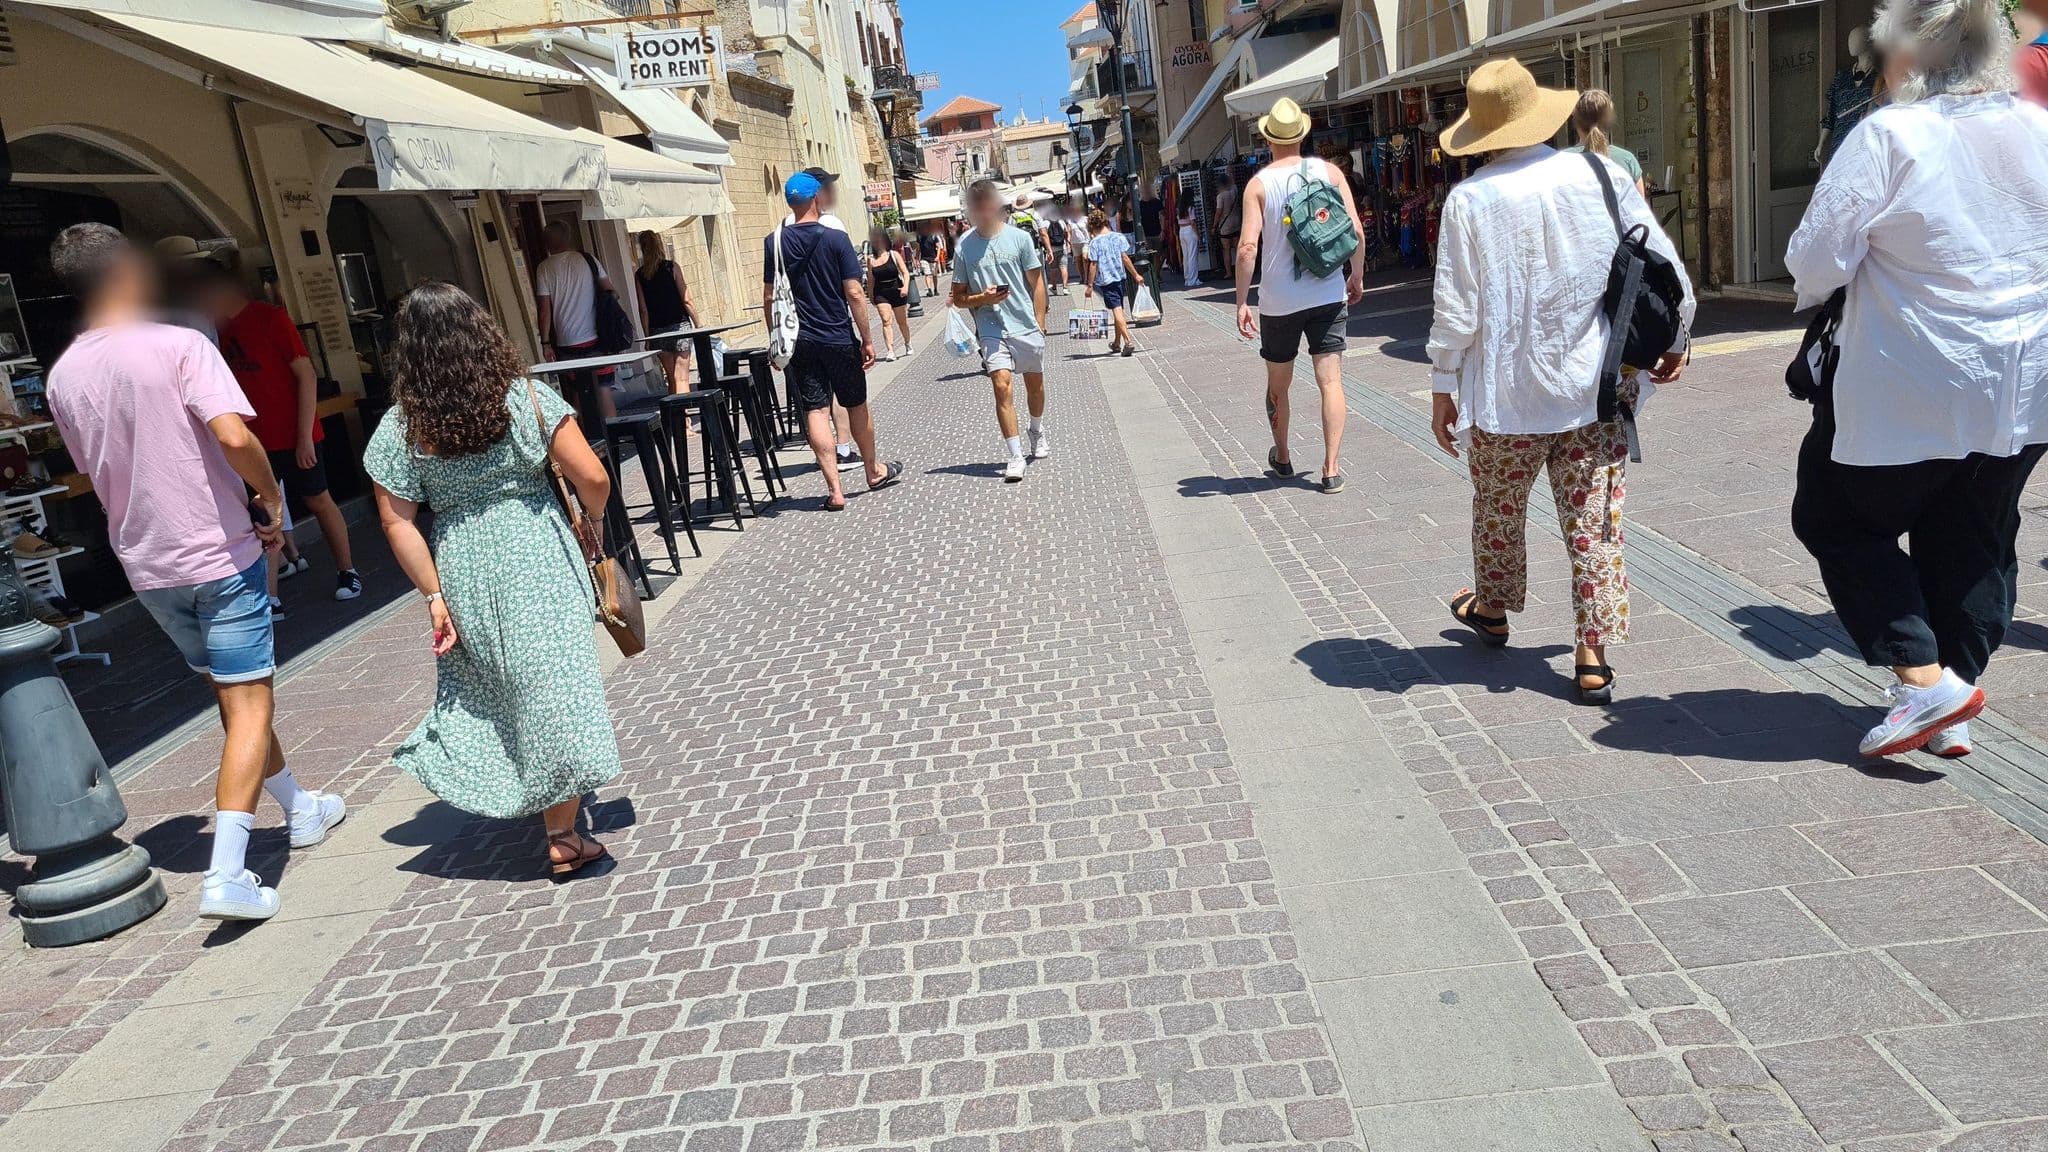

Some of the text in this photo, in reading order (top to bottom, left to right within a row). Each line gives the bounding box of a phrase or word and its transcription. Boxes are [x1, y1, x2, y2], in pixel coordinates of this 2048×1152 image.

[627, 36, 716, 59] ROOMS
[630, 59, 710, 79] FOR RENT
[1172, 51, 1211, 68] AGORA
[407, 137, 457, 171] CREAM
